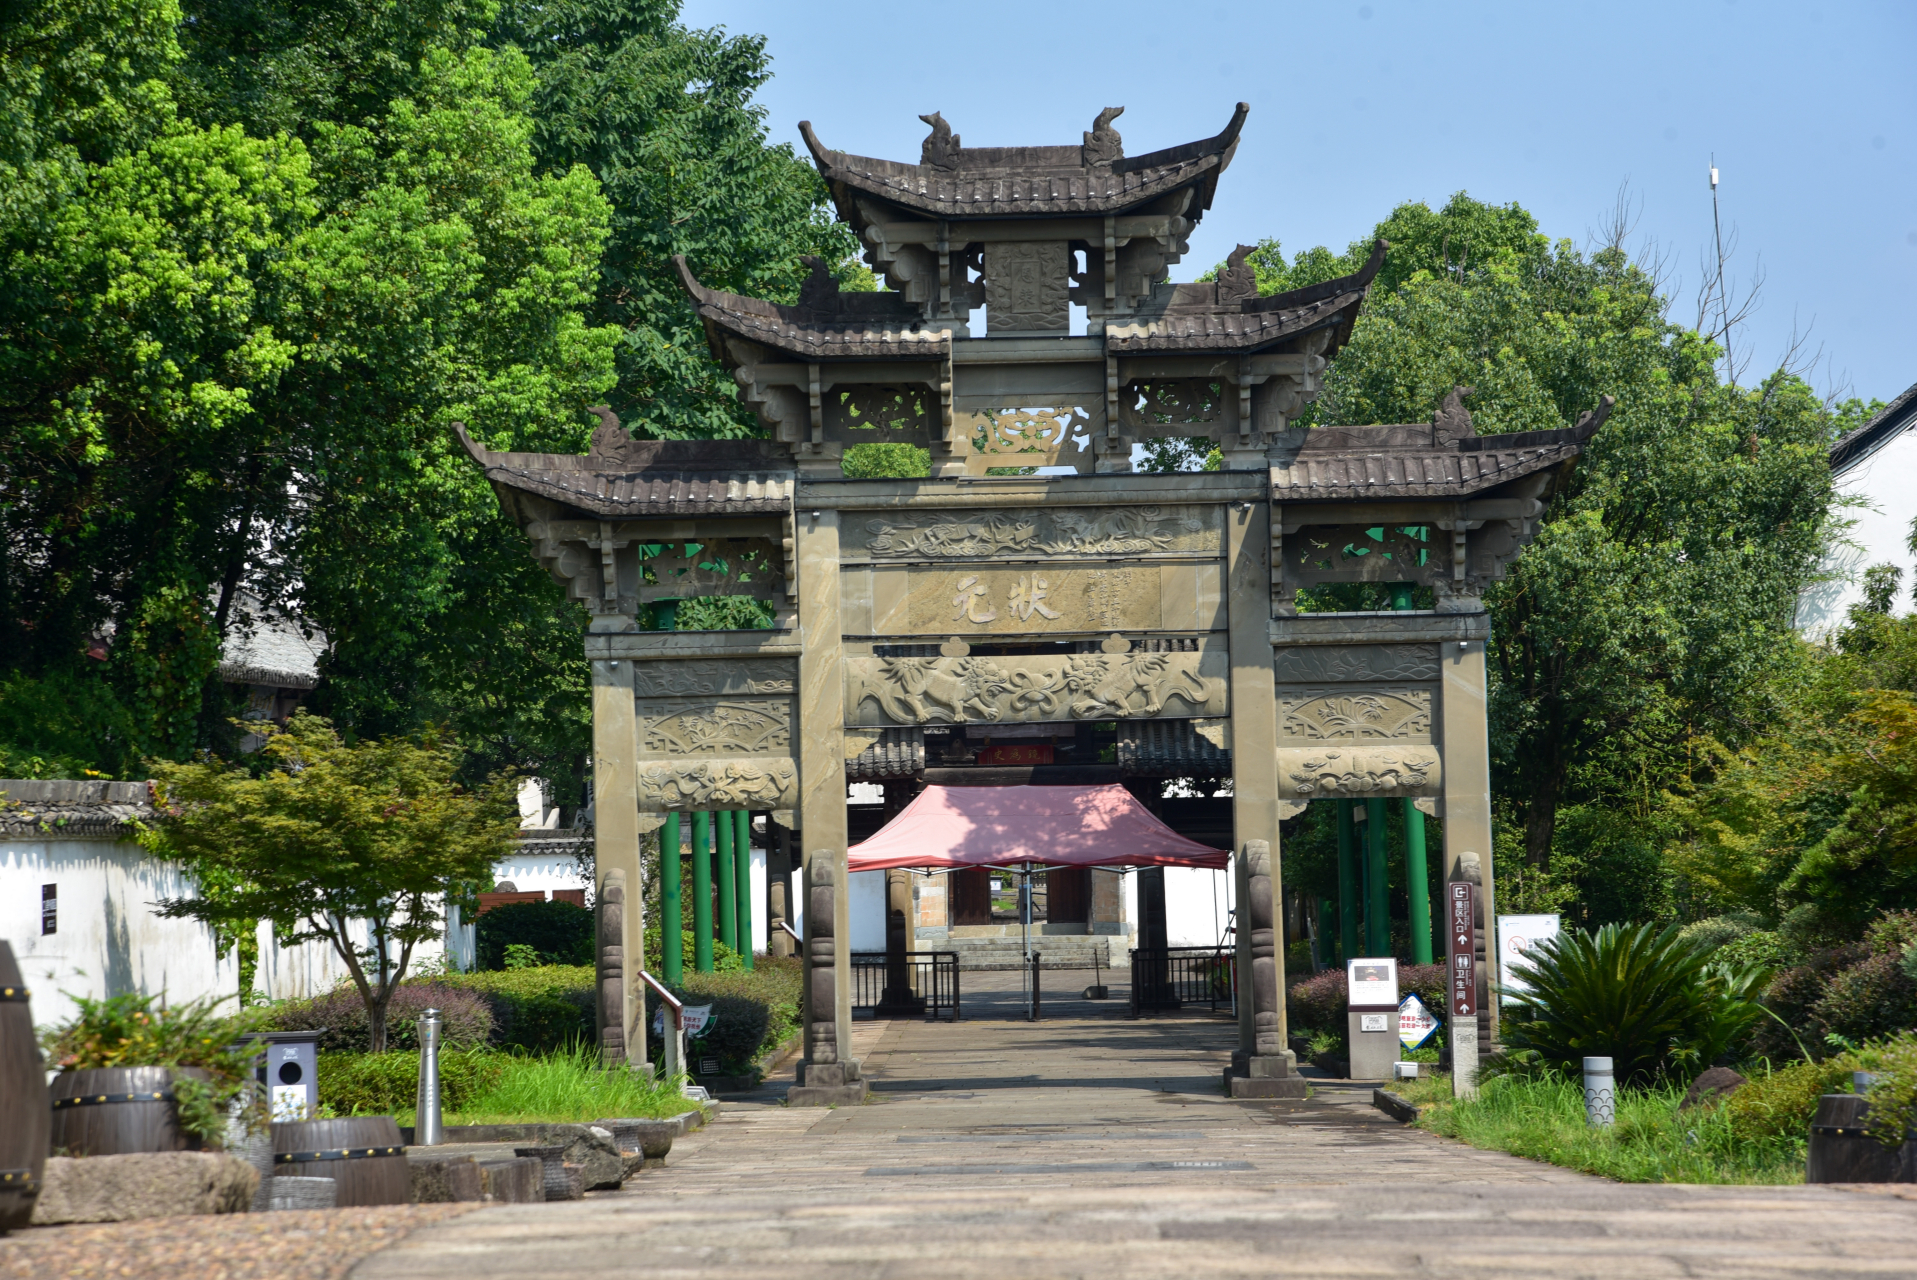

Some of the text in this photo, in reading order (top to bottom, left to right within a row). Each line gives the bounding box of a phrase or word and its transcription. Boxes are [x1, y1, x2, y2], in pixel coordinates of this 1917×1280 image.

[1455, 900, 1464, 933] 景区入口
[1455, 969, 1466, 1000] 卫生间
